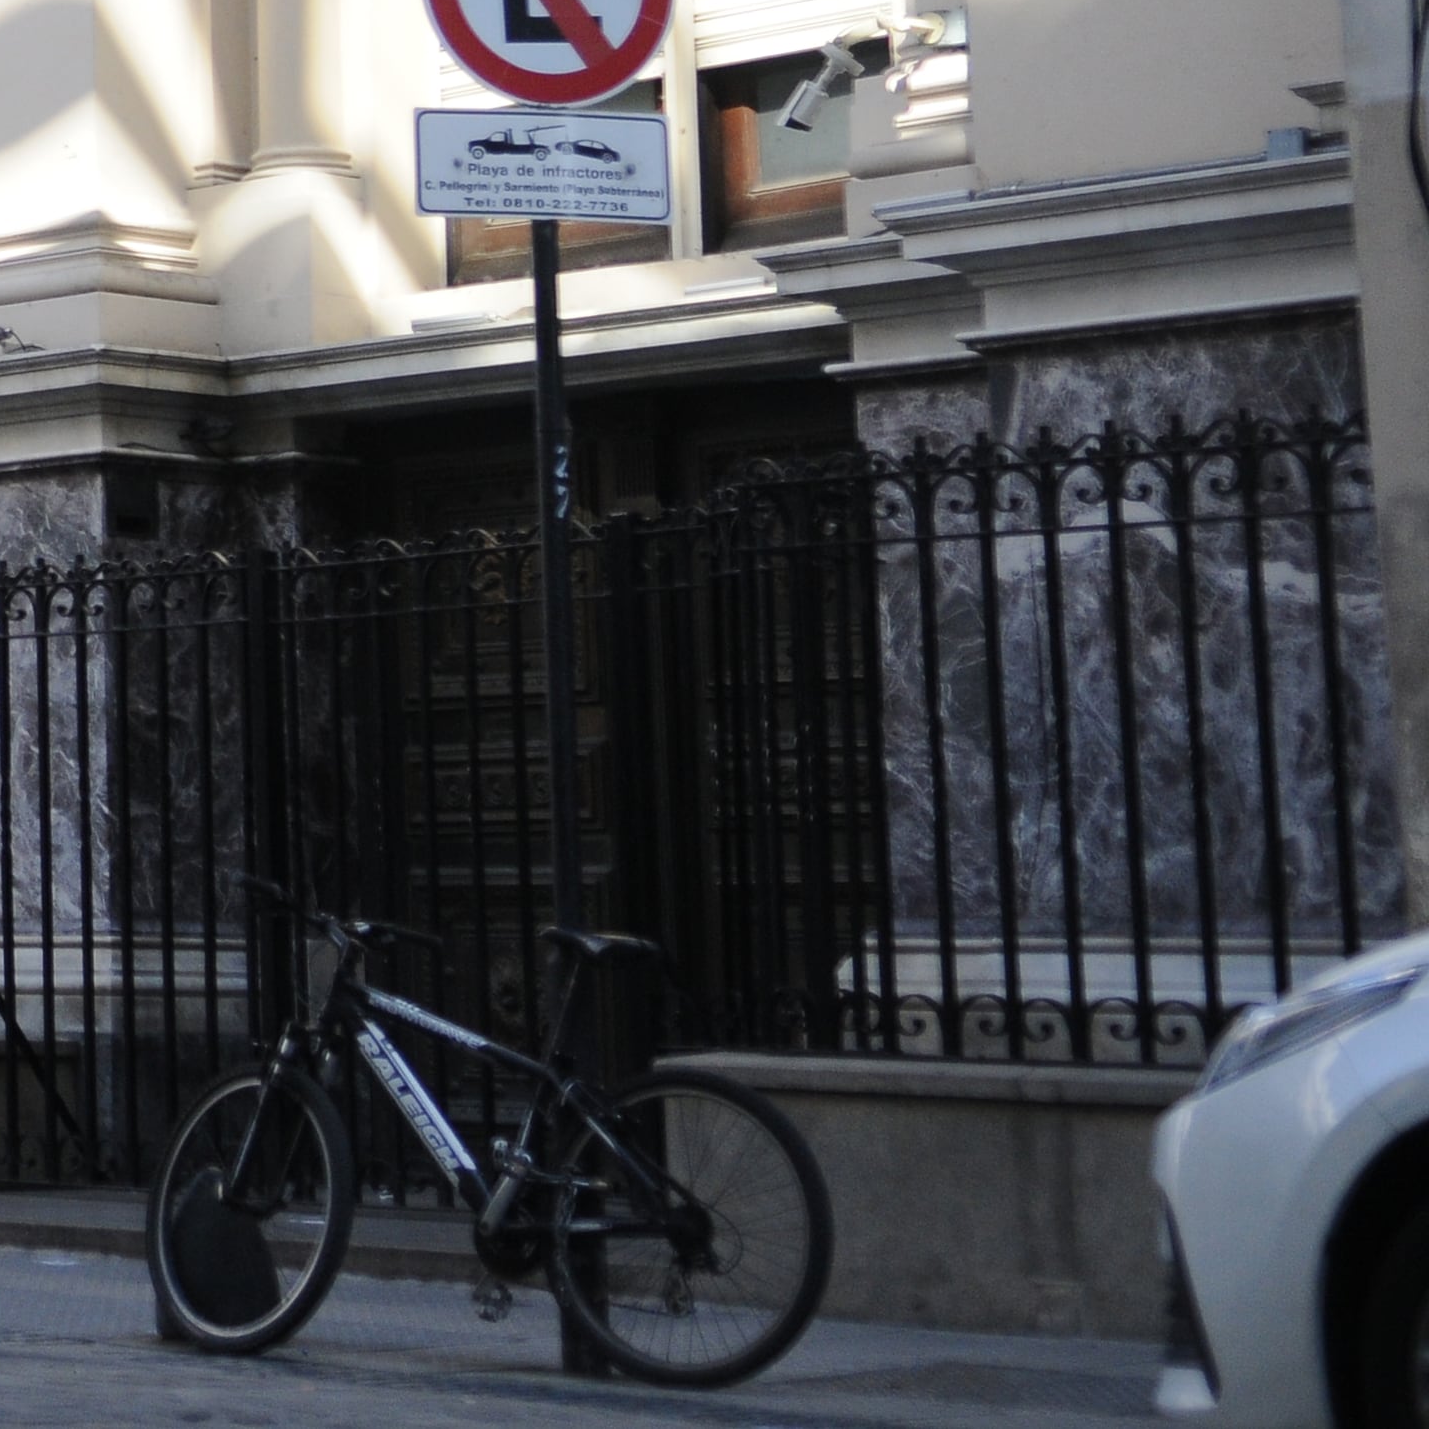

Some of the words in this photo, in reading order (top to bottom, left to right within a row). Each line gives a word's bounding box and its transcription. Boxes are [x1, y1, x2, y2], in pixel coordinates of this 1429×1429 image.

[467, 162, 509, 178] Playa
[516, 164, 535, 177] de
[542, 164, 623, 181] infractores
[424, 180, 436, 191] C.
[439, 180, 490, 193] Pellegrini
[503, 181, 560, 193] Sarmiento
[463, 196, 497, 208] Tel:
[502, 197, 629, 212] 0810-222-7736
[356, 1032, 462, 1172] RALEIGH
